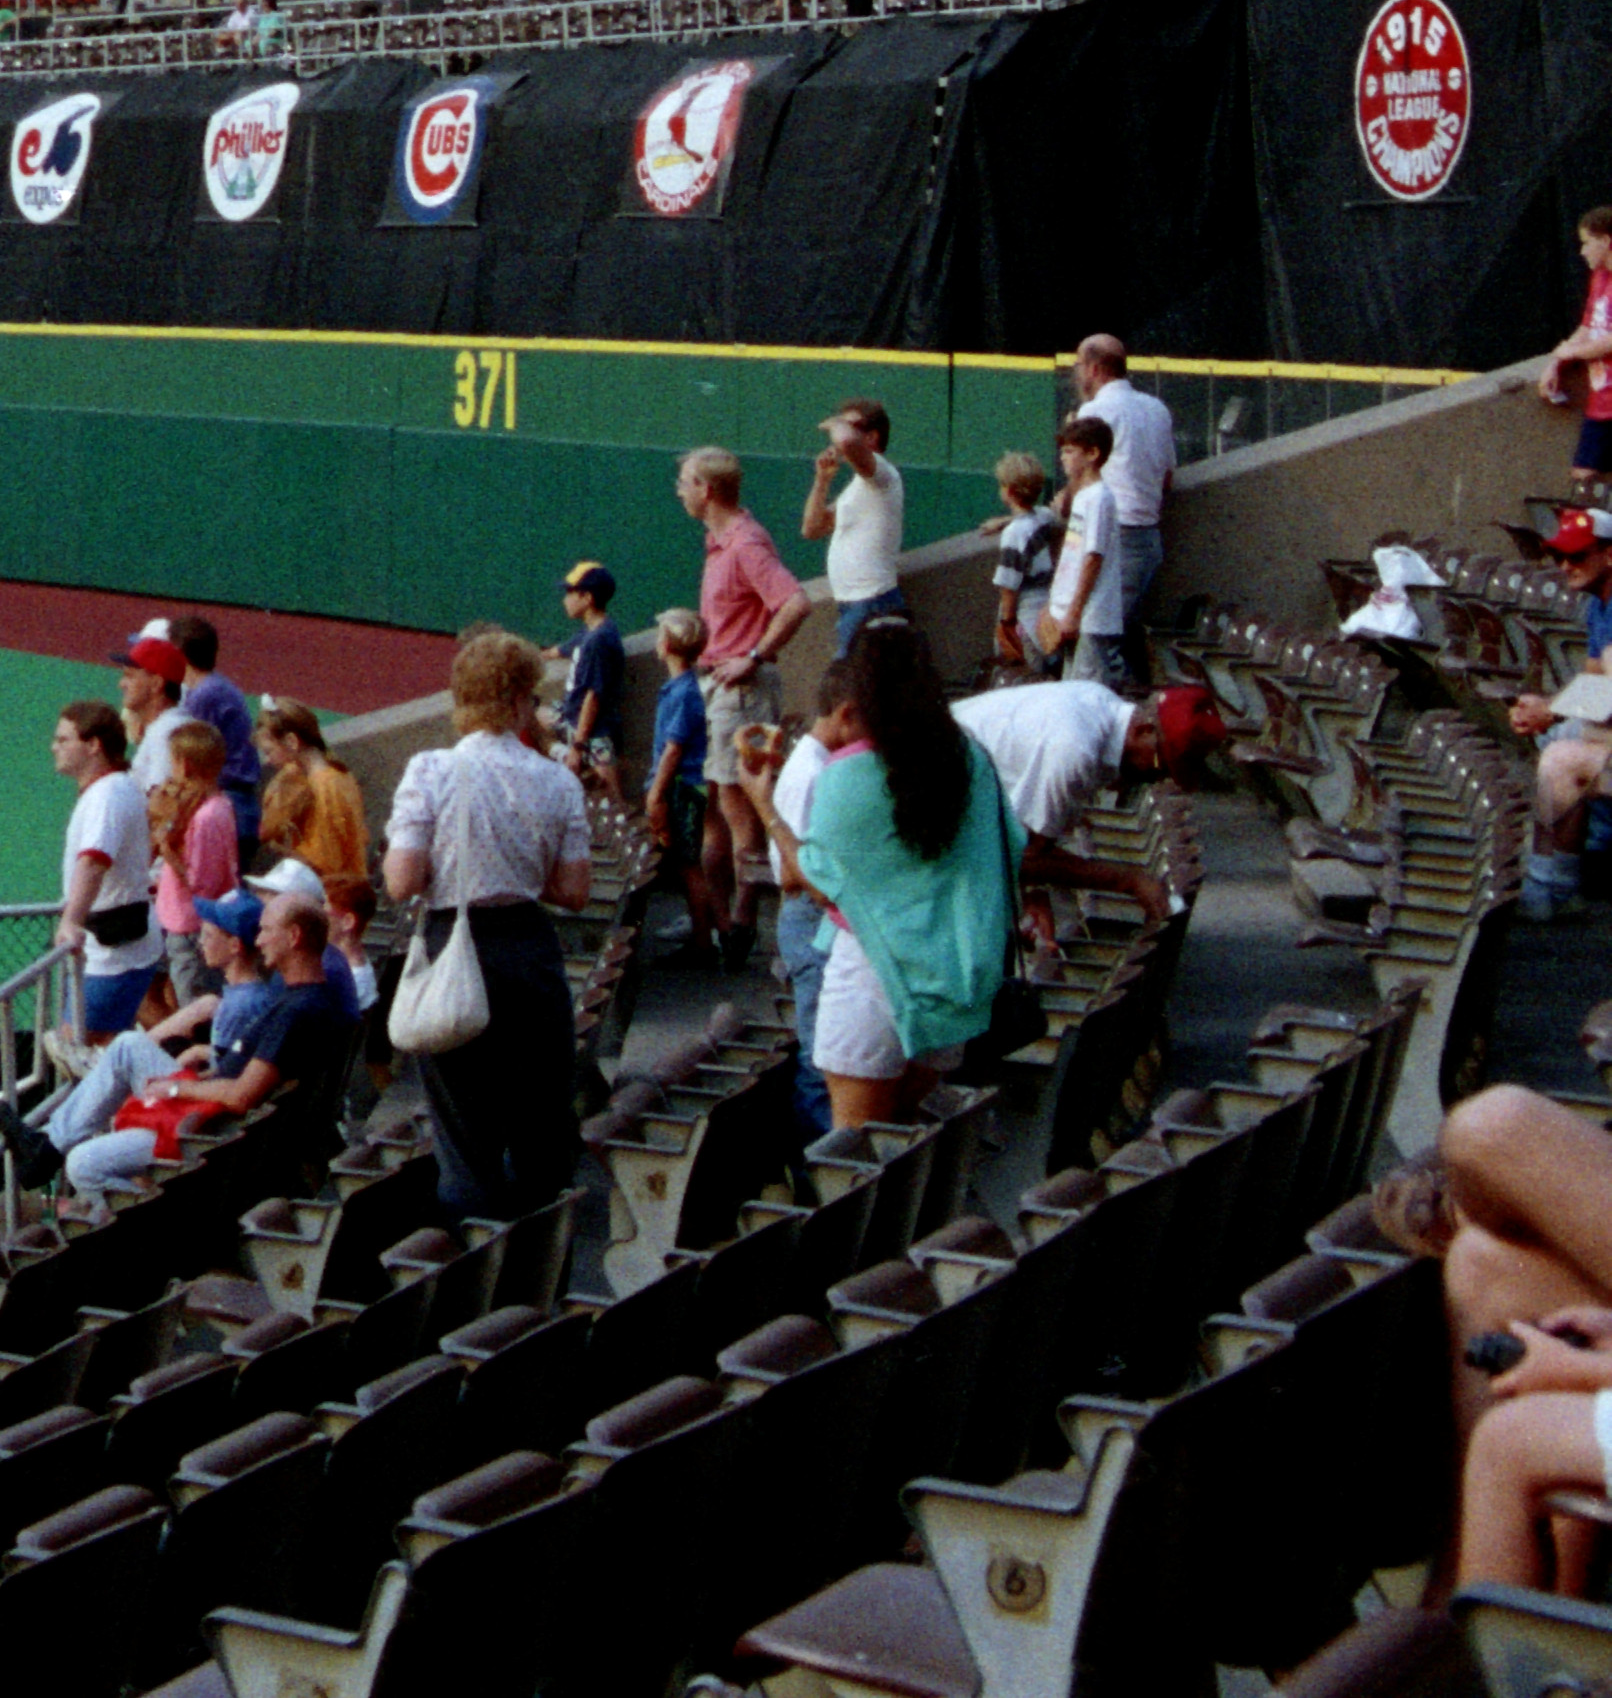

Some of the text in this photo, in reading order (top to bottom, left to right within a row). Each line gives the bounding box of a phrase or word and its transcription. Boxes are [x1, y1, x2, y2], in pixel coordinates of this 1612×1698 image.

[1376, 6, 1448, 65] 1915
[1383, 68, 1442, 96] NATIONAL
[1388, 96, 1441, 121] LEAGUE
[410, 93, 471, 197] CUBS
[1367, 108, 1460, 187] CHAMPIONS
[453, 349, 517, 430] 371
